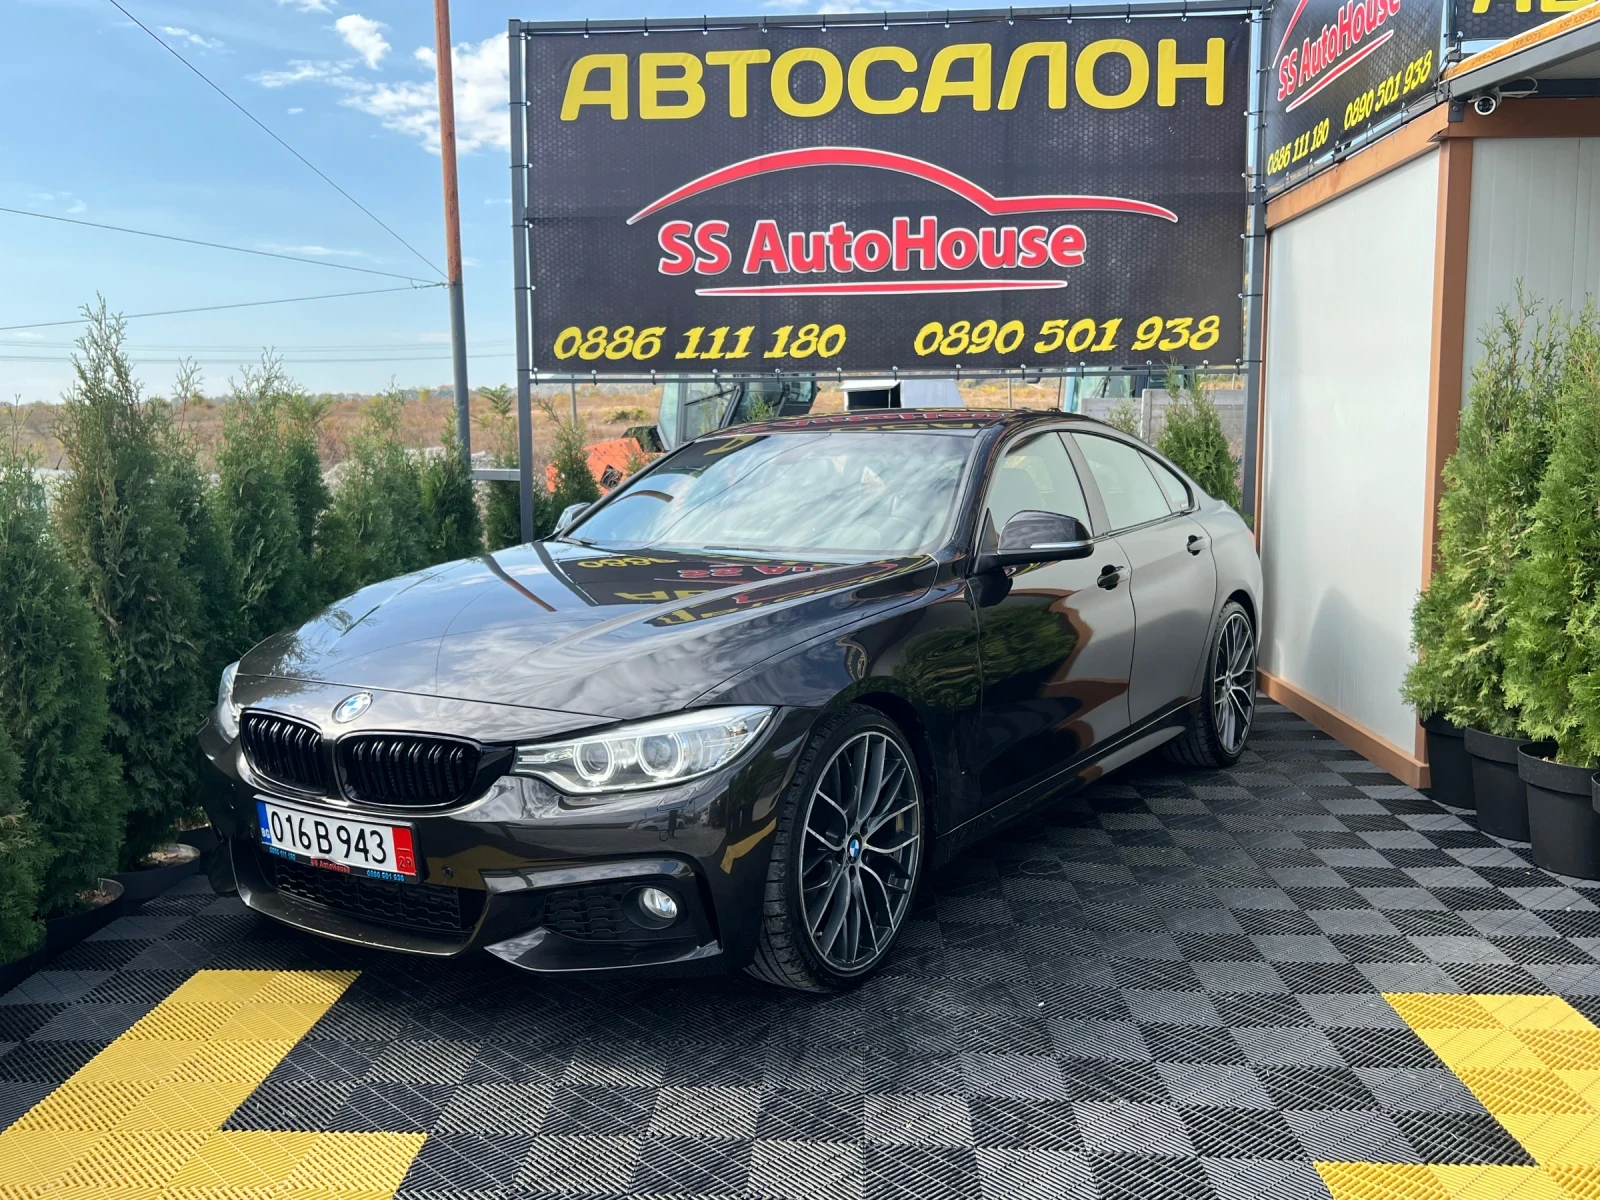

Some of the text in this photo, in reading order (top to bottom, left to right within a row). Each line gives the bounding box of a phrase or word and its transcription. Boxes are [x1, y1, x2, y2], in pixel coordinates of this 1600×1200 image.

[560, 38, 1225, 121] АВТОСАЛОН
[1278, 48, 1298, 101] SS
[1344, 50, 1432, 131] 0890 501 938
[1267, 118, 1330, 176] 0886 111 180
[657, 215, 1087, 275] SS AutoHouse
[553, 324, 847, 361] 0886 111 180
[913, 315, 1220, 357] 0890 501 938
[261, 827, 271, 838] BG
[398, 856, 413, 869] 29
